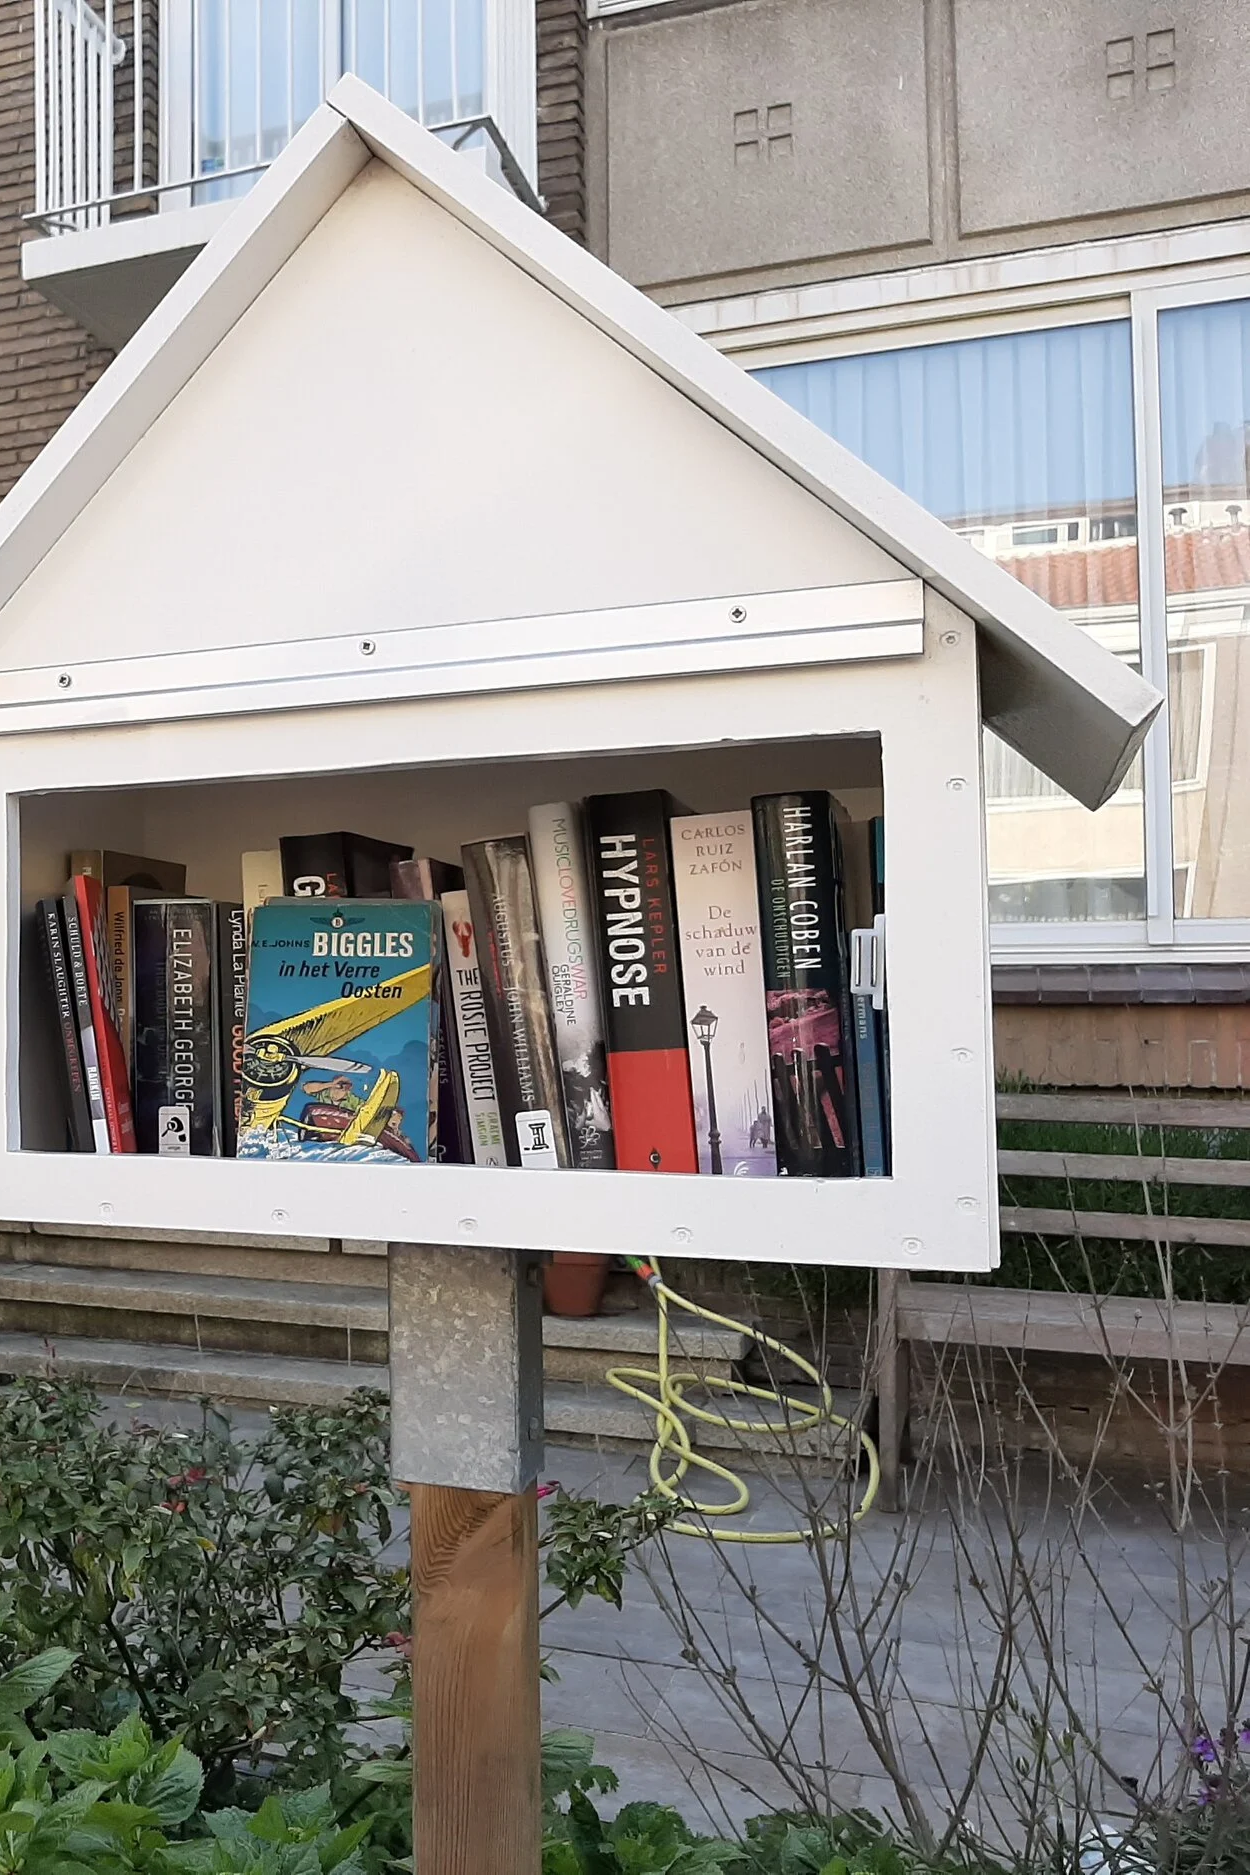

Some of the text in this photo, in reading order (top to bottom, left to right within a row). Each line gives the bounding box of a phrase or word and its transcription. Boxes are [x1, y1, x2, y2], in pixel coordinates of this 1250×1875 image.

[681, 824, 746, 841] CARLOS
[696, 843, 734, 857] RUIZ
[690, 859, 743, 876] ZAFÓN
[783, 806, 822, 969] HARLAN COBEN
[600, 834, 650, 1008] HYPNOSE
[642, 838, 667, 974] LARS KEPLER
[709, 906, 731, 919] De
[69, 917, 81, 958] SCHULD
[114, 911, 125, 955] Wilfried
[228, 910, 246, 950] Lynda
[313, 932, 414, 957] BIGGLES
[686, 923, 757, 941] schaduw
[48, 913, 60, 948] KARIN
[54, 952, 70, 1018] SLAUGHTER
[114, 958, 125, 972] de
[233, 954, 246, 971] La
[696, 942, 751, 958] van de
[173, 929, 193, 1030] ELIZABETH
[279, 960, 380, 978] in het Verre
[456, 968, 479, 986] THE
[704, 960, 746, 976] wind
[341, 982, 402, 999] Oosten
[503, 986, 524, 1023] JOHN
[552, 966, 565, 1014] QUIGLEY
[559, 964, 576, 1026] GERALDINE
[466, 1043, 495, 1100] PROJECT
[513, 1028, 535, 1102] WILLIAMS
